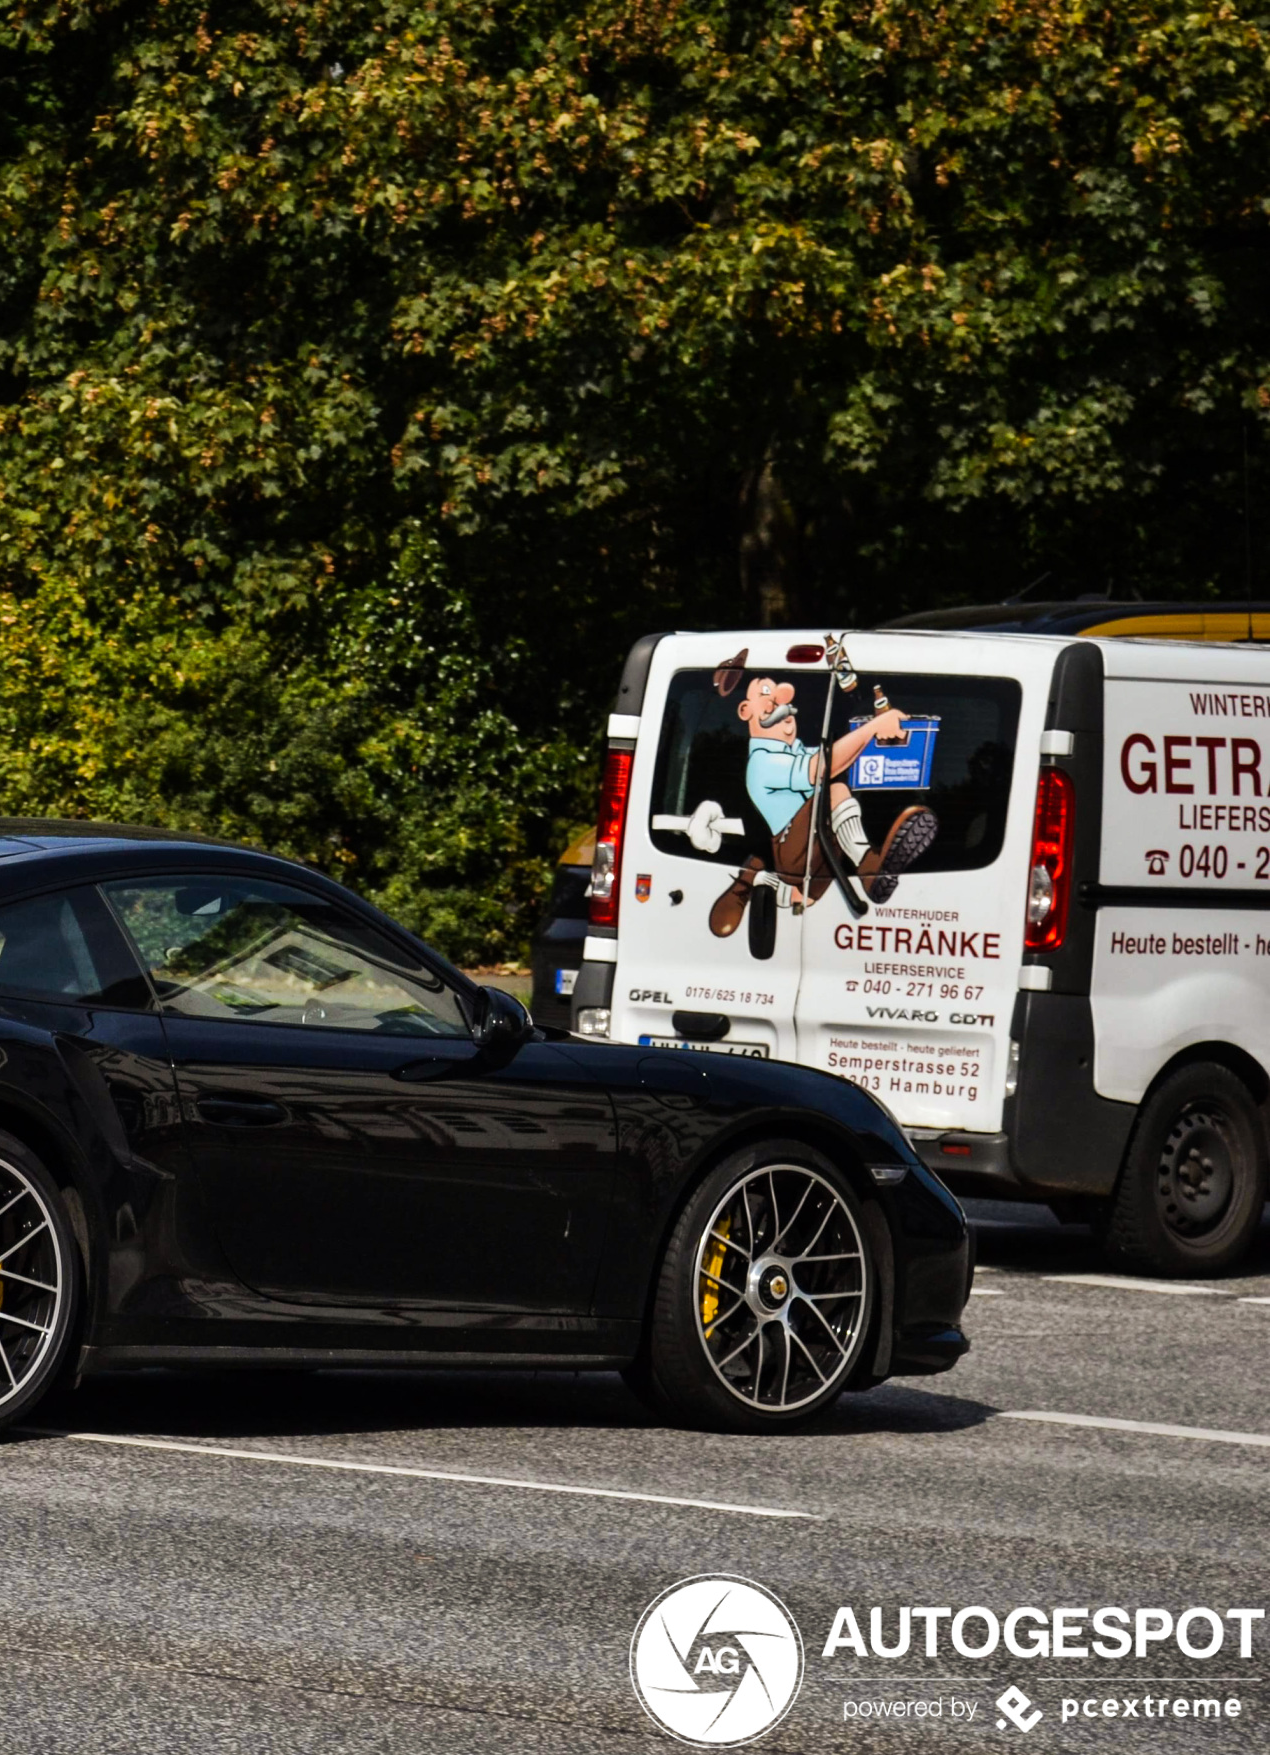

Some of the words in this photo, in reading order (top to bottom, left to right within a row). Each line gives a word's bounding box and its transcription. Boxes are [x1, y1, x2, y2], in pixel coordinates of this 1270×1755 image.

[1189, 692, 1270, 718] WINTER
[1120, 732, 1270, 798] GETR
[1179, 804, 1270, 833] LIEFERS
[1179, 844, 1228, 879] 040
[875, 907, 959, 922] WINTERHUDER
[833, 923, 1001, 960] GETRÄNKE
[1110, 931, 1167, 955] Heute
[1172, 932, 1239, 955] bestellt
[1255, 933, 1270, 956] h
[864, 962, 966, 979] LIEFERSERVICE
[629, 988, 674, 1004] OPEL
[685, 986, 736, 1002] 0176/625
[739, 992, 752, 1003] 18
[755, 993, 775, 1005] 734
[862, 979, 891, 995] 040
[906, 982, 933, 998] 271
[939, 984, 959, 1000] 96
[964, 986, 985, 1001] 67
[865, 1006, 940, 1023] VIVARO
[949, 1013, 995, 1027] CDTI
[829, 1038, 859, 1050] Heute
[861, 1040, 898, 1052] bestellt
[906, 1043, 935, 1055] heute
[937, 1045, 980, 1059] geliefert
[827, 1052, 956, 1076] Semperstrasse
[960, 1062, 980, 1077] 52
[889, 1077, 978, 1101] Hamburg
